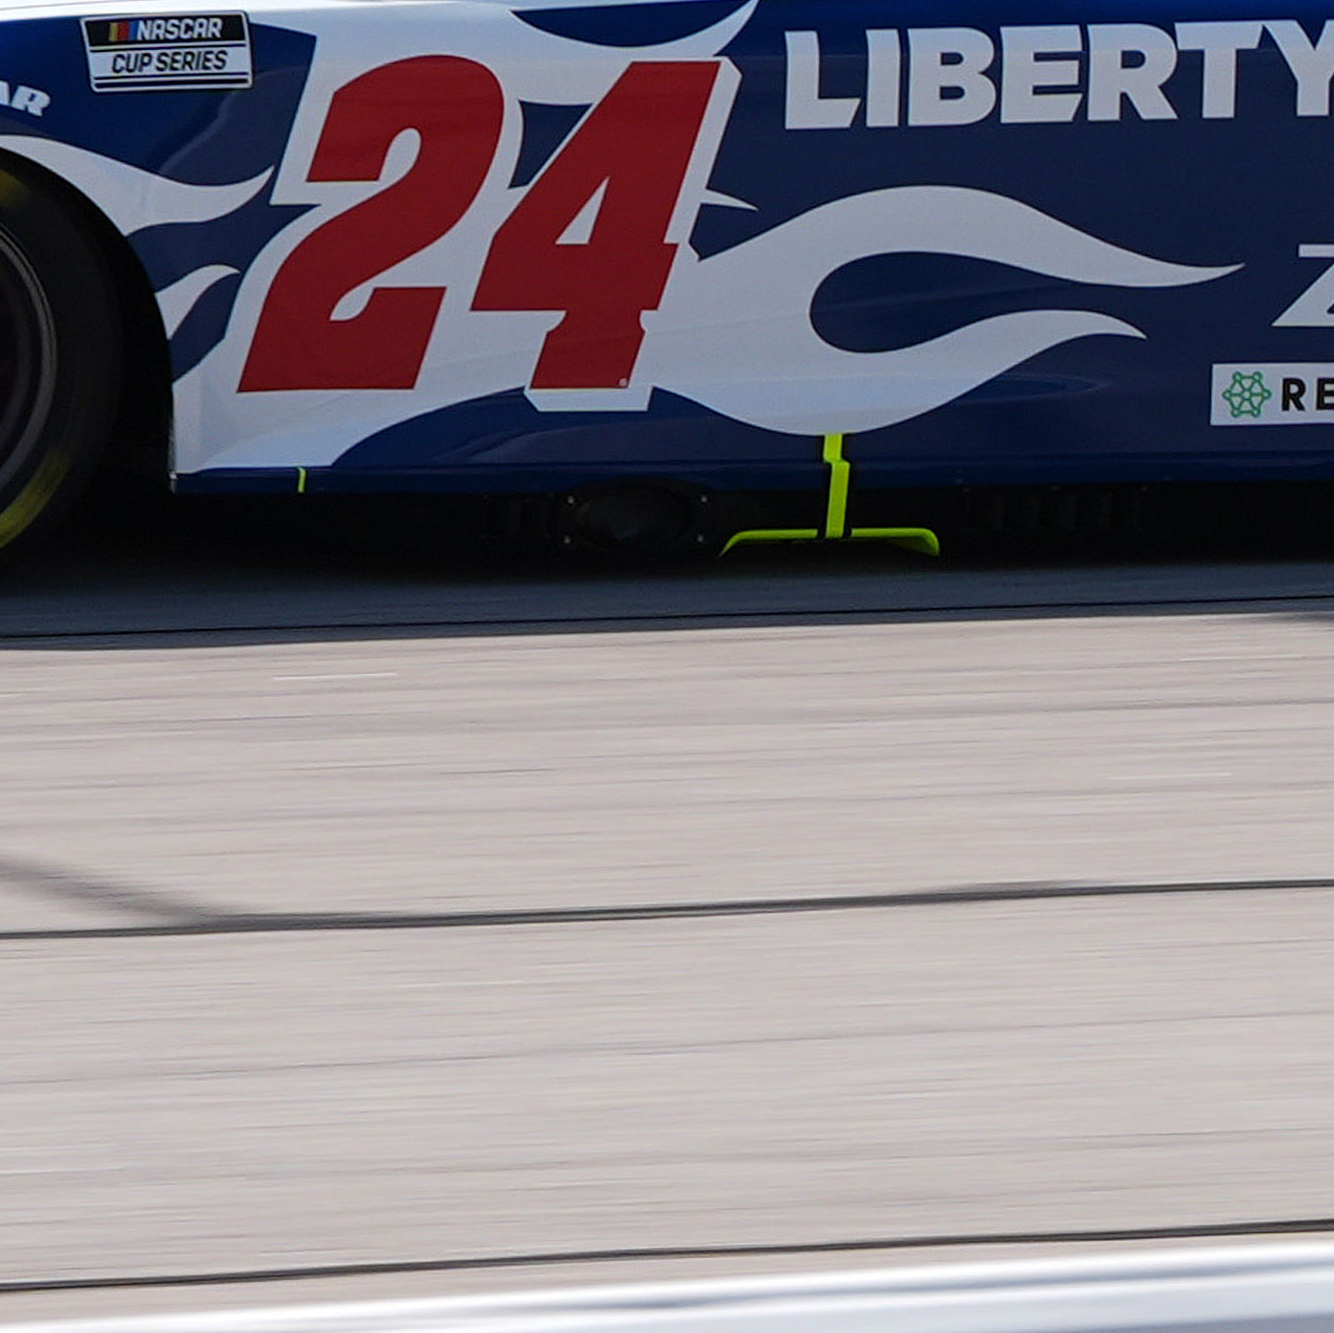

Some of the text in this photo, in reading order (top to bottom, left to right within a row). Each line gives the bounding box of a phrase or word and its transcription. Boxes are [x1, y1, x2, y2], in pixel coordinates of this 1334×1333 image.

[135, 18, 222, 40] NASCAR
[111, 50, 228, 74] CUP SERIES
[238, 54, 723, 394] 24
